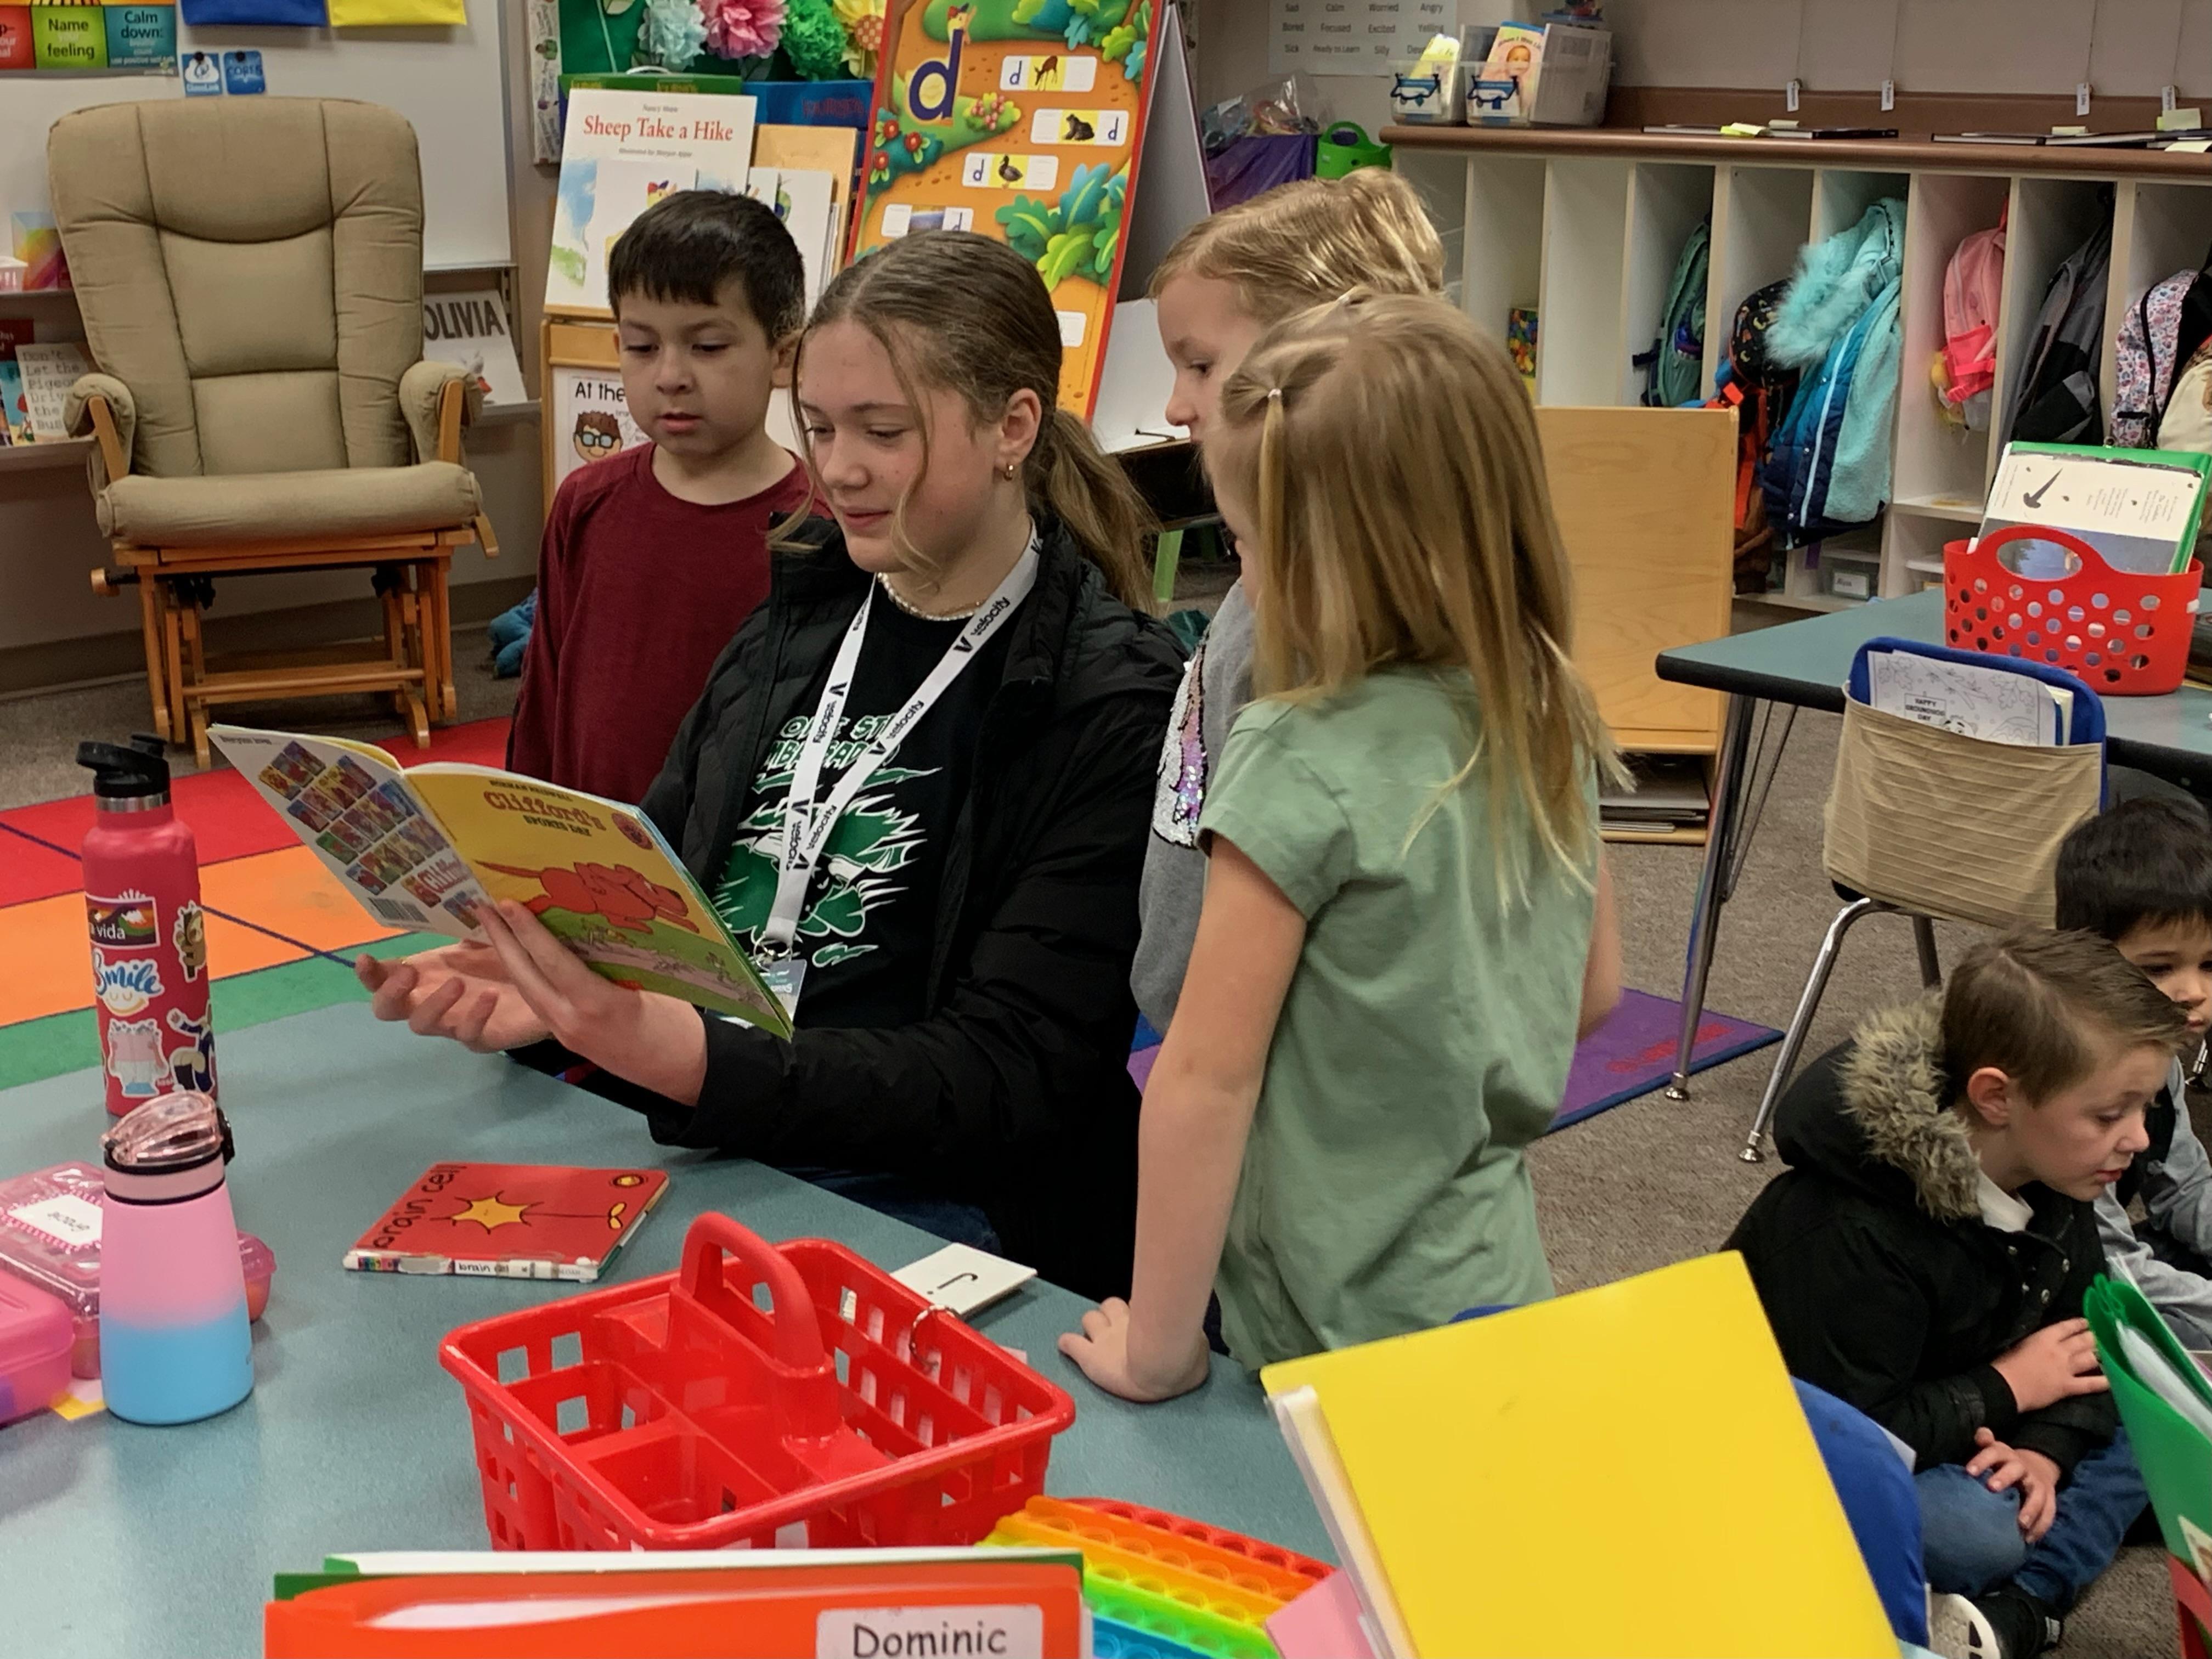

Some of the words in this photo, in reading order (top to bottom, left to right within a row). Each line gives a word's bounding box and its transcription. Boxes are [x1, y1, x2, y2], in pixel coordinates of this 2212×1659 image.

[1325, 3, 1345, 12] Calm
[1369, 3, 1398, 12] Worried
[1420, 3, 1443, 14] Angry
[48, 19, 89, 31] Name
[125, 11, 157, 24] Calm
[121, 25, 163, 39] down:
[48, 44, 95, 60] feeling
[909, 29, 964, 120] d
[1009, 60, 1023, 85] d
[584, 115, 631, 142] Sheep
[637, 117, 674, 138] Take
[679, 123, 687, 139] a
[693, 120, 733, 141] Hike
[1108, 117, 1119, 141] d
[973, 159, 984, 182] d
[22, 350, 61, 361] Don't
[26, 364, 48, 375] Let
[56, 361, 80, 374] the
[31, 392, 64, 403] Driv
[575, 382, 592, 399] At
[599, 383, 625, 402] the
[35, 406, 60, 416] the
[970, 596, 1011, 636] velocity
[1905, 705, 1945, 716] GROUNDHOG
[1915, 698, 1937, 707] HAPPY
[813, 701, 837, 743] velocity
[886, 700, 924, 739] velocity
[483, 791, 606, 831] Clifford's
[806, 805, 837, 850] velocity
[97, 923, 126, 939] vida
[94, 952, 162, 996] Smile
[421, 1164, 467, 1193] cell
[459, 1263, 490, 1272] brain
[854, 1621, 1007, 1658] Dominic
